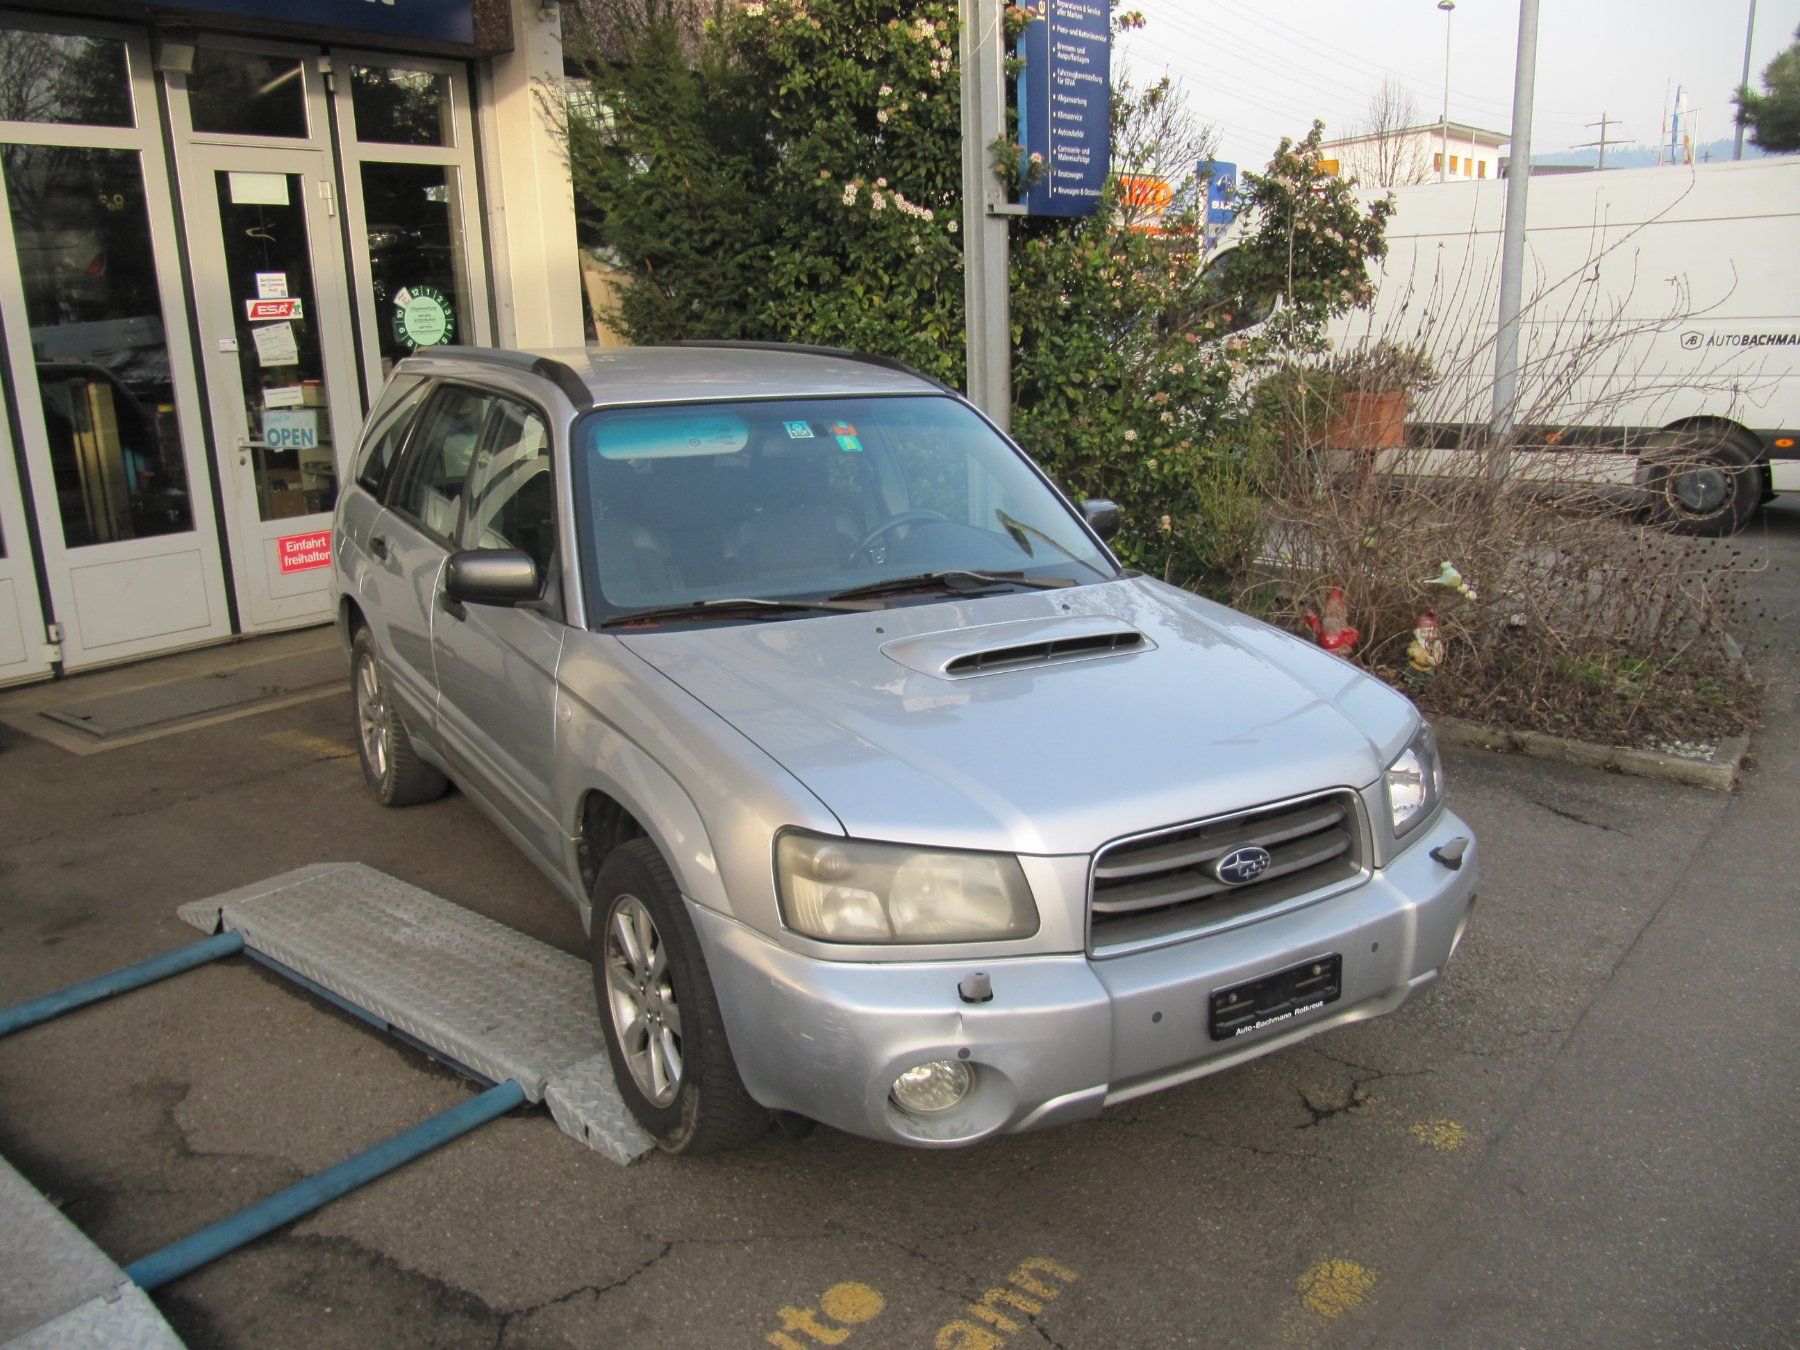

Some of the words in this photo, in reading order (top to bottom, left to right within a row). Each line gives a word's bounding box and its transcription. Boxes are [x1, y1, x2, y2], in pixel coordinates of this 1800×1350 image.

[1087, 5, 1100, 16] Service
[1070, 28, 1078, 37] und
[1077, 46, 1085, 54] und
[411, 288, 420, 297] 12
[396, 309, 404, 318] 10
[441, 337, 448, 345] 5
[1706, 334, 1800, 347] AUTOBACHMA
[267, 427, 314, 447] OPEN
[285, 536, 327, 553] Einfahrt
[1294, 1000, 1324, 1016] Rotkreuz
